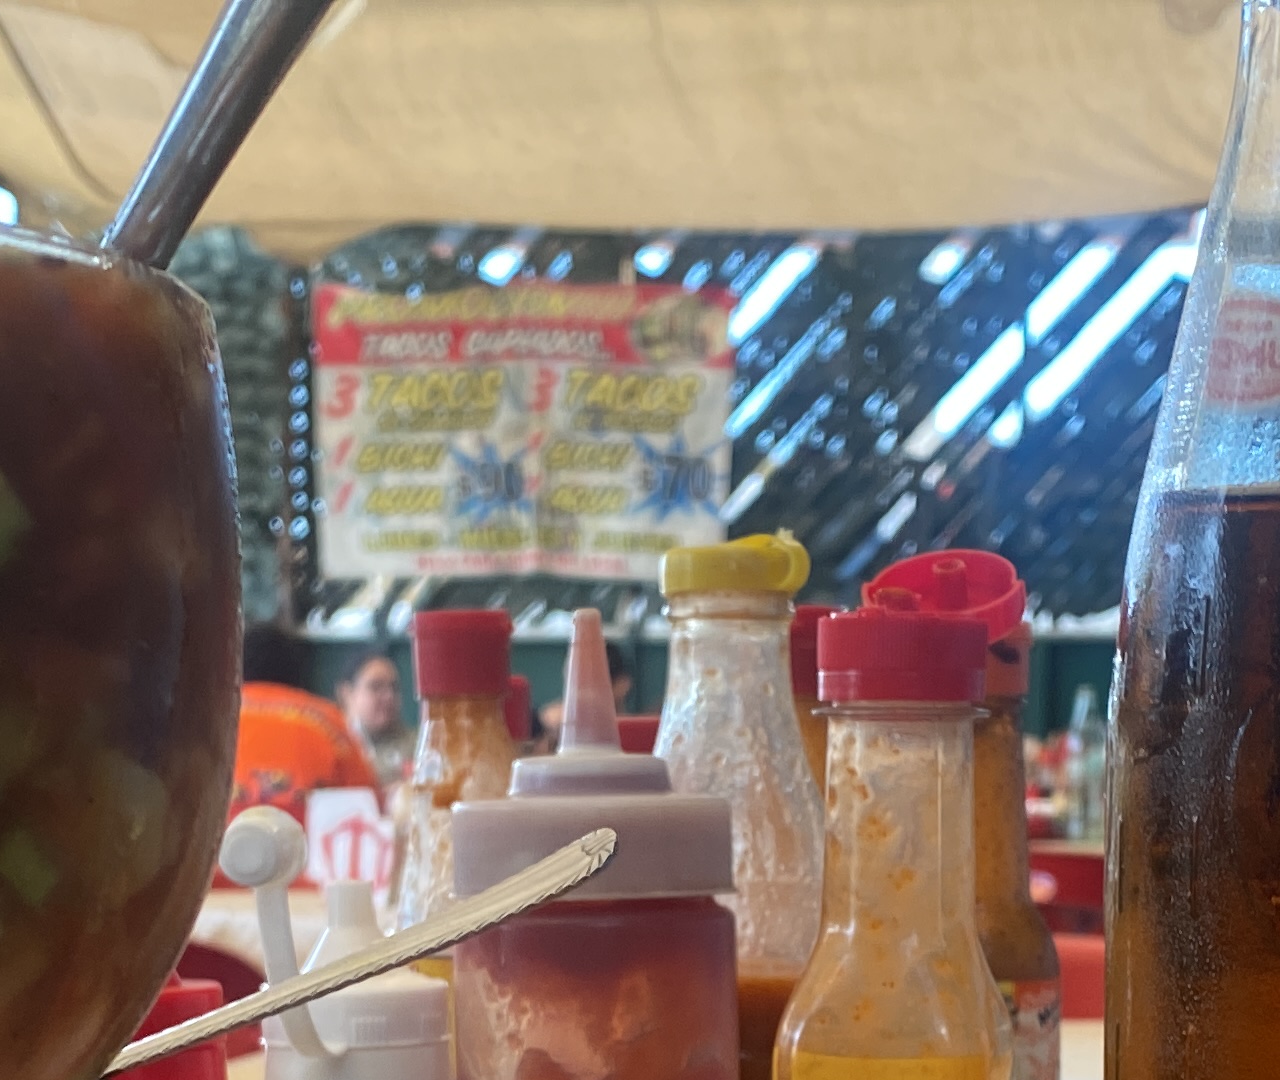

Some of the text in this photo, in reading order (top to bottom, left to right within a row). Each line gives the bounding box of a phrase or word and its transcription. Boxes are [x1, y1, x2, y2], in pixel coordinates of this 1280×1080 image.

[325, 368, 504, 418] 3 TACOS
[532, 368, 701, 416] 3 TACOS
